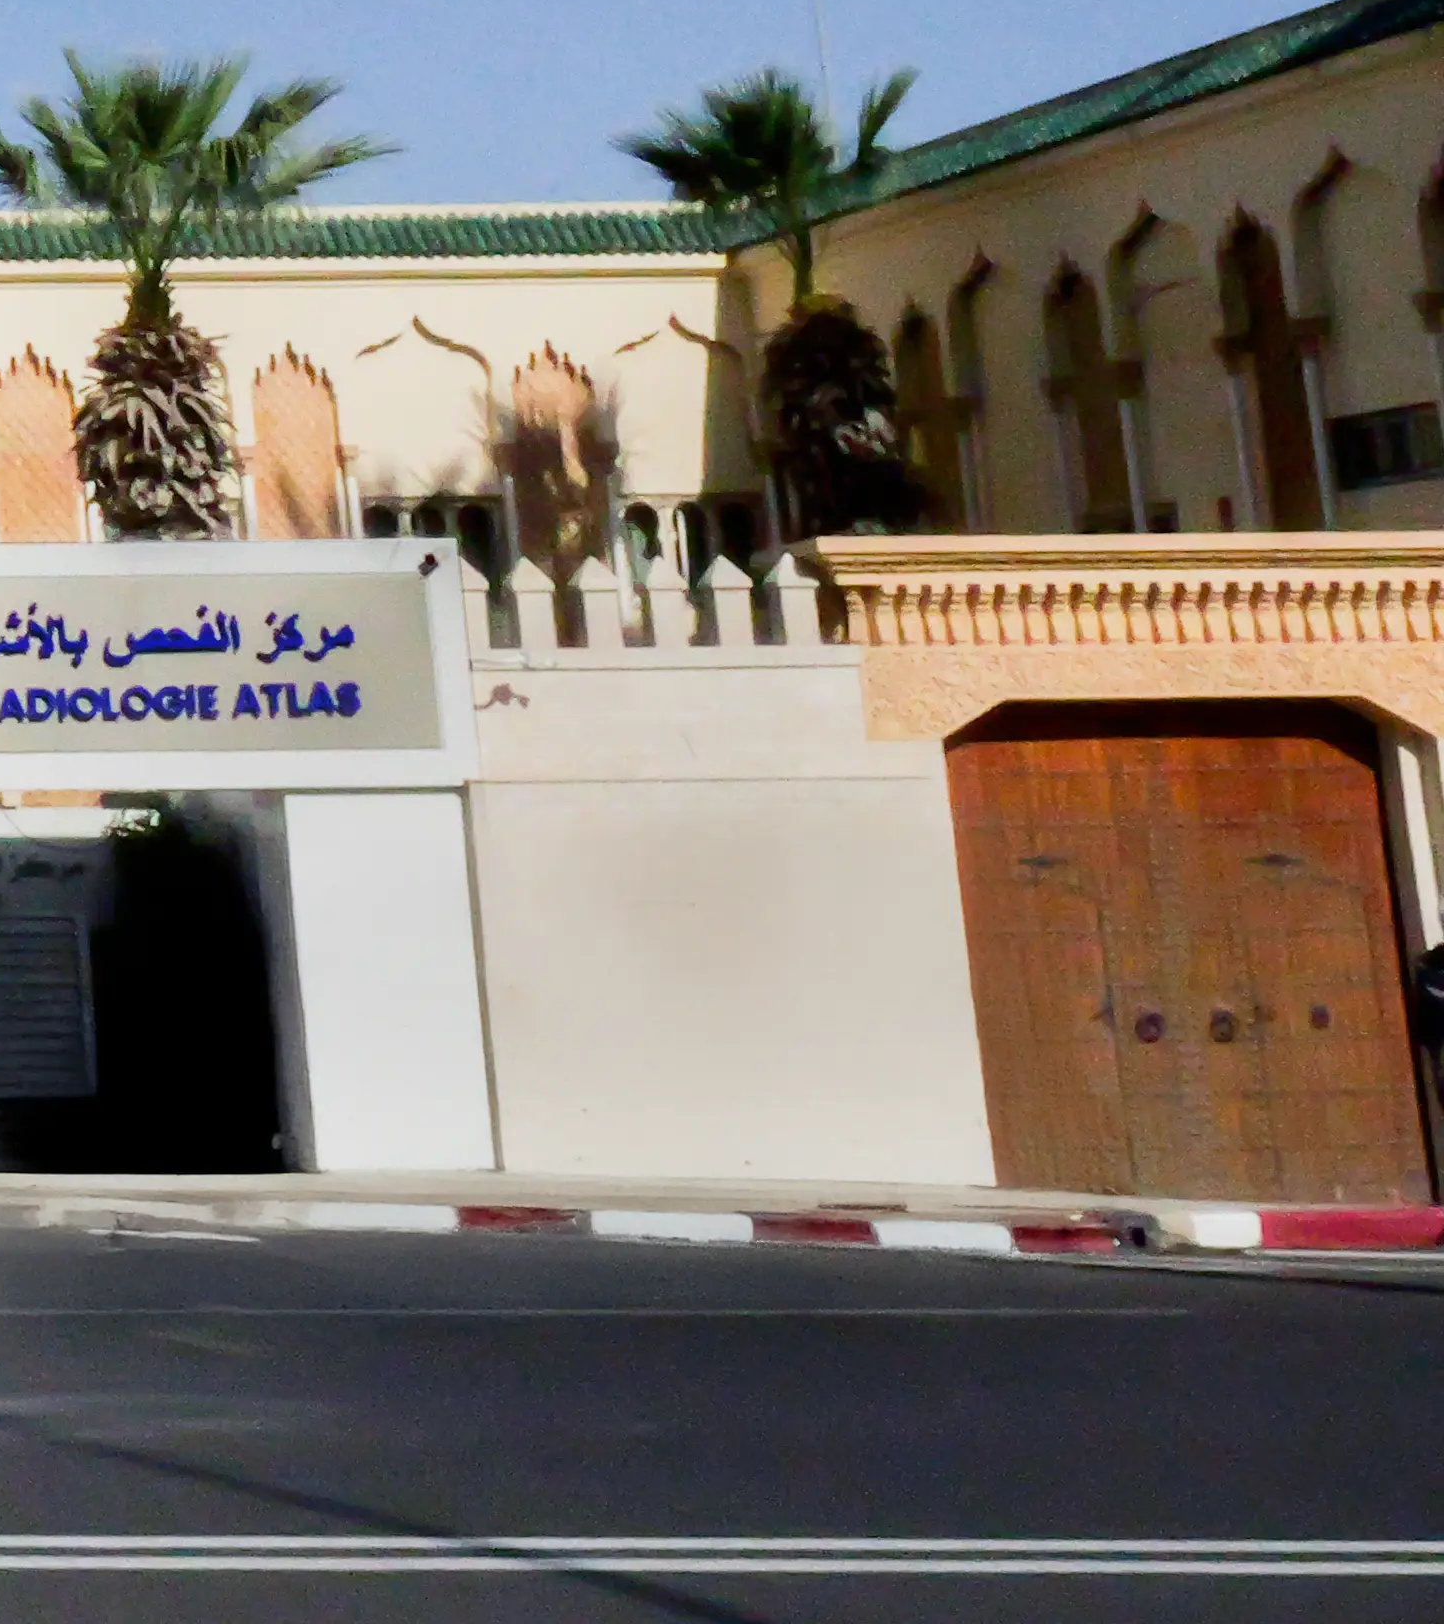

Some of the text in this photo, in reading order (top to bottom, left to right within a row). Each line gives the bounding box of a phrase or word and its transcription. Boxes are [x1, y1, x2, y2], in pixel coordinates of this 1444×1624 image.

[103, 605, 241, 668] الفحص
[256, 612, 355, 664] مركز
[232, 682, 361, 719] ATLAS
